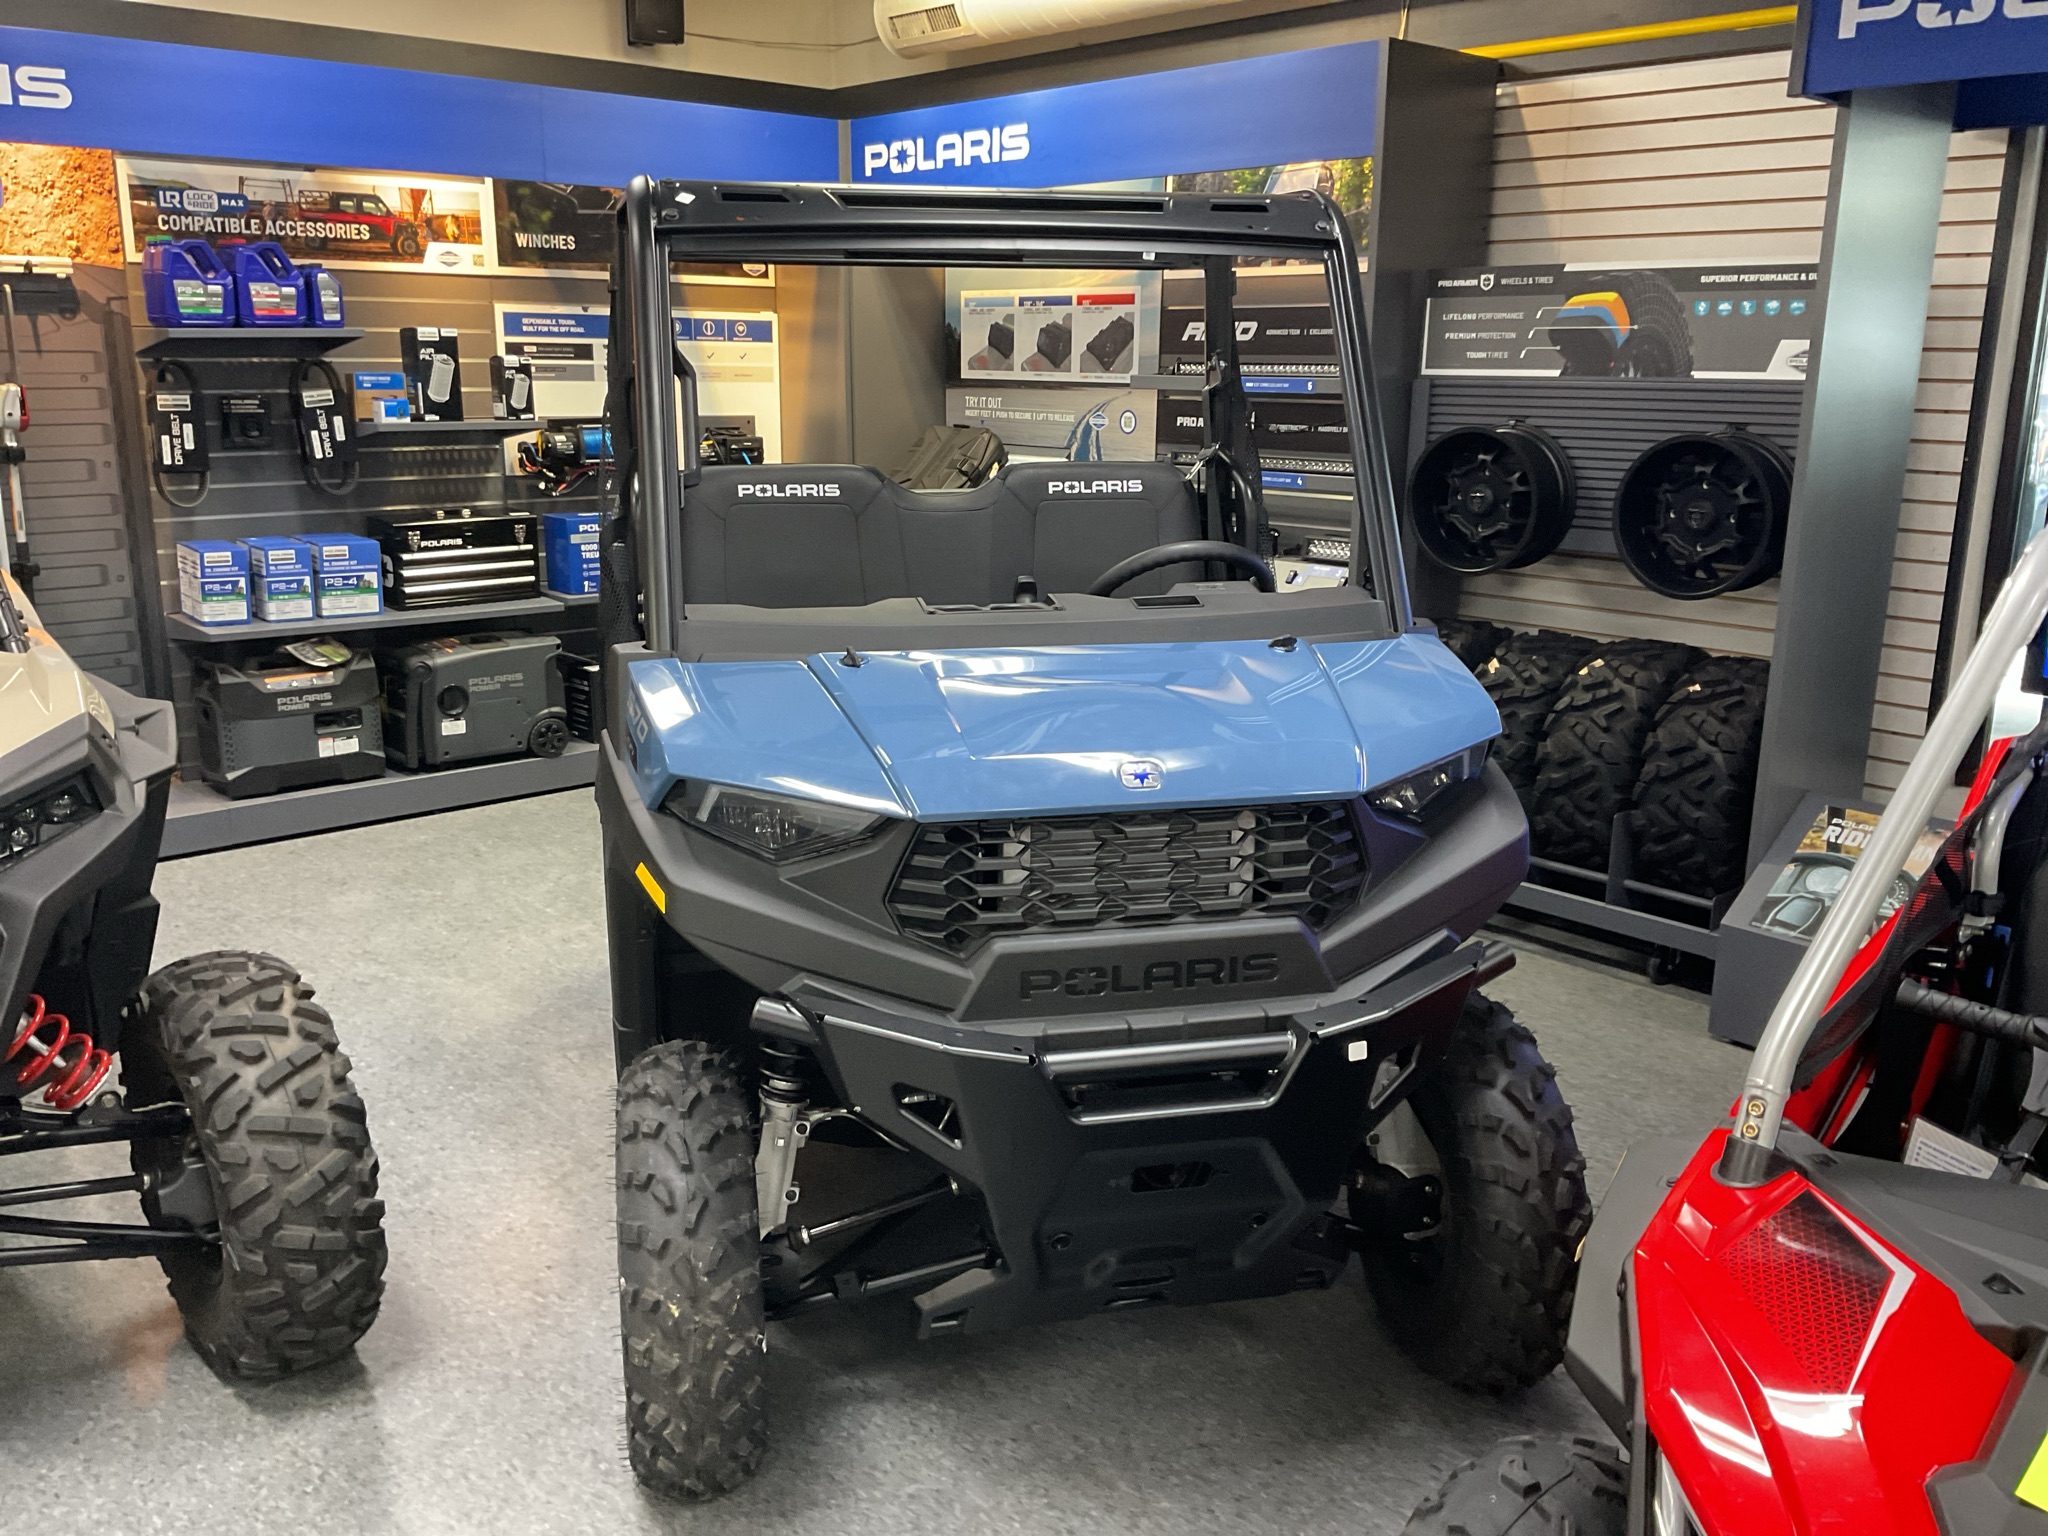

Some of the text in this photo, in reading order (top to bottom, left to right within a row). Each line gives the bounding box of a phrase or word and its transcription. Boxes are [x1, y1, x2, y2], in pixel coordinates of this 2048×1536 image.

[864, 121, 1031, 177] POLARIS
[186, 192, 214, 201] LOCK
[220, 197, 245, 208] MAX
[157, 213, 371, 241] COMPATIBLE ACCESSORIES
[514, 231, 577, 251] WINCHES
[1500, 277, 1528, 285] WHEELS
[1535, 276, 1554, 284] TIRES
[1700, 274, 1739, 283] SUPERIOR
[1739, 272, 1800, 282] PERFORMANCE
[1800, 272, 1807, 280] &
[1442, 311, 1525, 320] LIFELONG PERFORMANCE
[1444, 331, 1517, 340] PREMIUM PROTECTION
[1466, 351, 1509, 359] TOUGH TIRES
[1307, 381, 1313, 391] 5
[964, 396, 1002, 409] TRY IT OUT
[964, 409, 980, 417] INSERT
[1008, 411, 1014, 419] TO
[1014, 411, 1032, 419] SECURE
[1054, 414, 1076, 422] RELEASE
[1176, 417, 1197, 427] PRO
[170, 413, 184, 465] DRIVE BELT
[316, 408, 334, 458] DRIVE BELT
[736, 482, 841, 498] POLARIS
[1047, 479, 1144, 495] POLARIS
[420, 537, 463, 548] POLARIS
[583, 580, 589, 593] 1
[468, 672, 524, 686] POLARIS
[468, 684, 501, 693] POWER
[277, 692, 332, 705] POLARIS
[277, 702, 310, 712] POWER
[1019, 952, 1280, 1001] POLARIS
